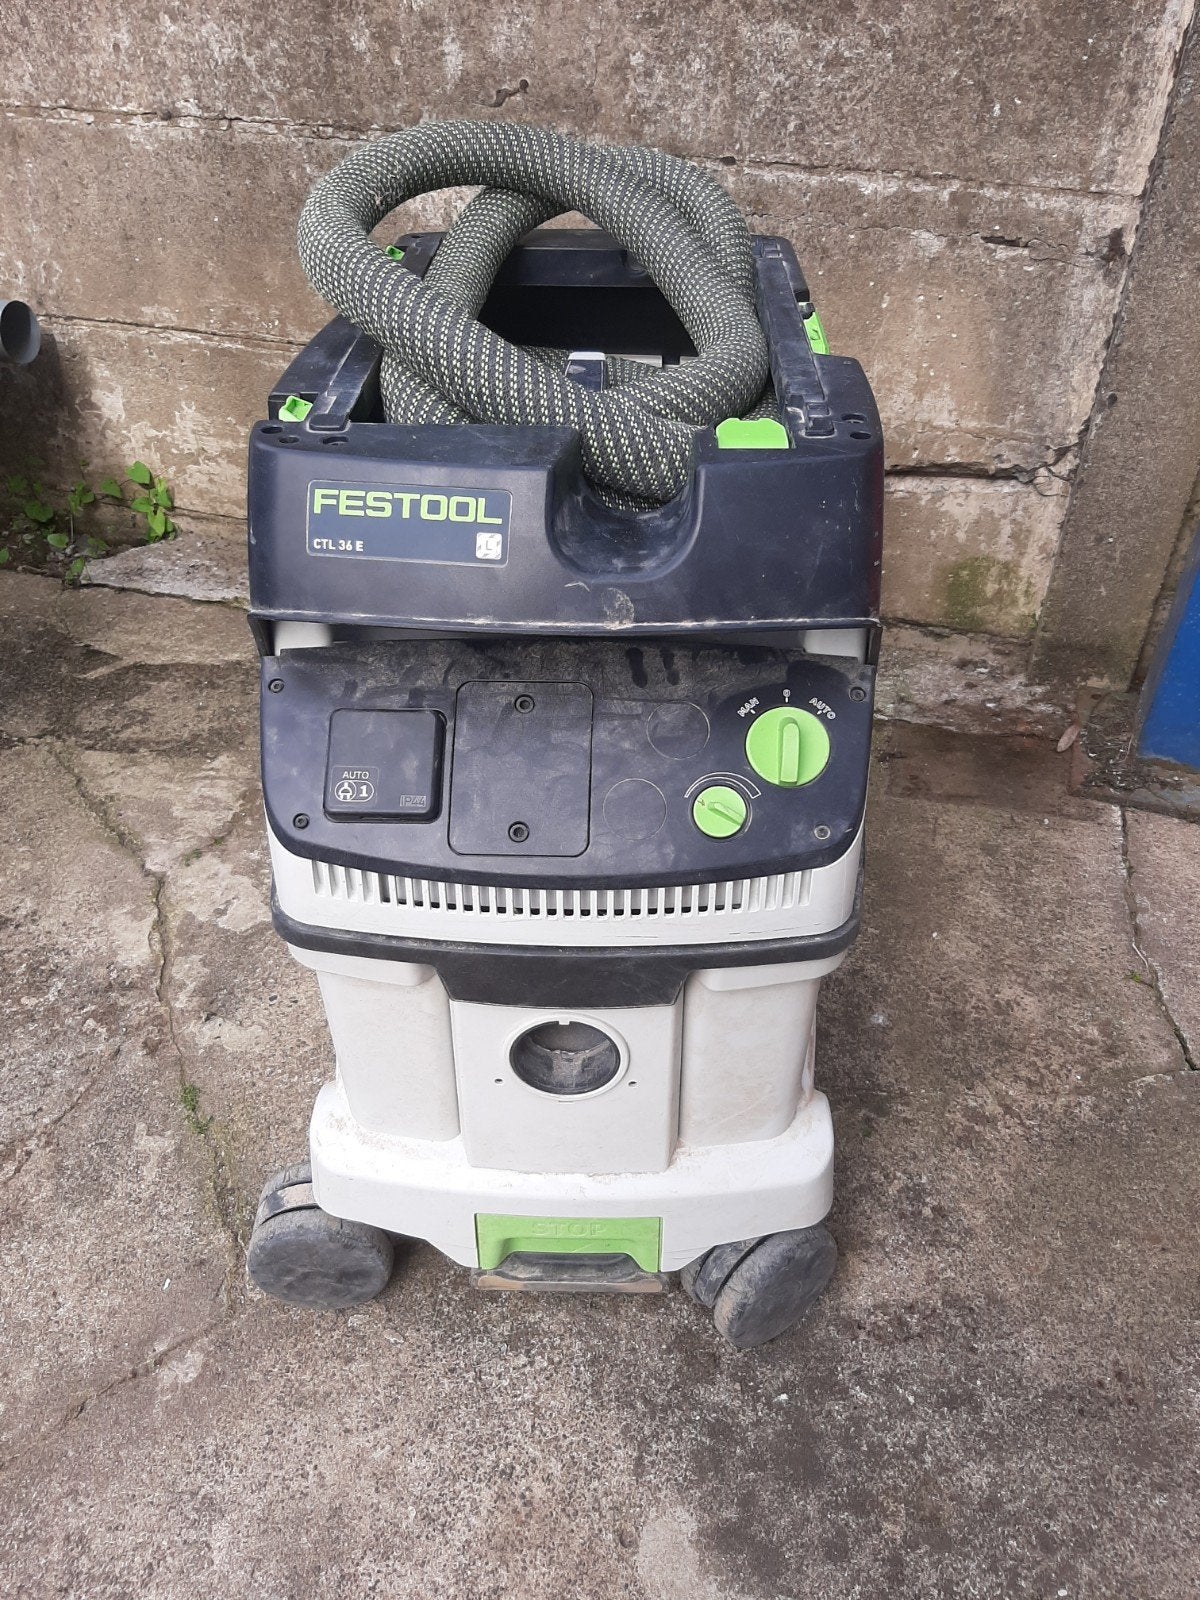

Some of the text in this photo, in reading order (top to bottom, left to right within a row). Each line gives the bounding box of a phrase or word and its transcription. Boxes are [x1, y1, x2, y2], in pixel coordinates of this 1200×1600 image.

[313, 488, 502, 525] FESTOOL
[313, 538, 364, 552] CTL 36 E
[737, 697, 760, 718] MAN
[809, 697, 836, 720] AUTO
[342, 771, 370, 780] AUTO
[359, 784, 369, 798] 1
[533, 1222, 607, 1237] STOP
